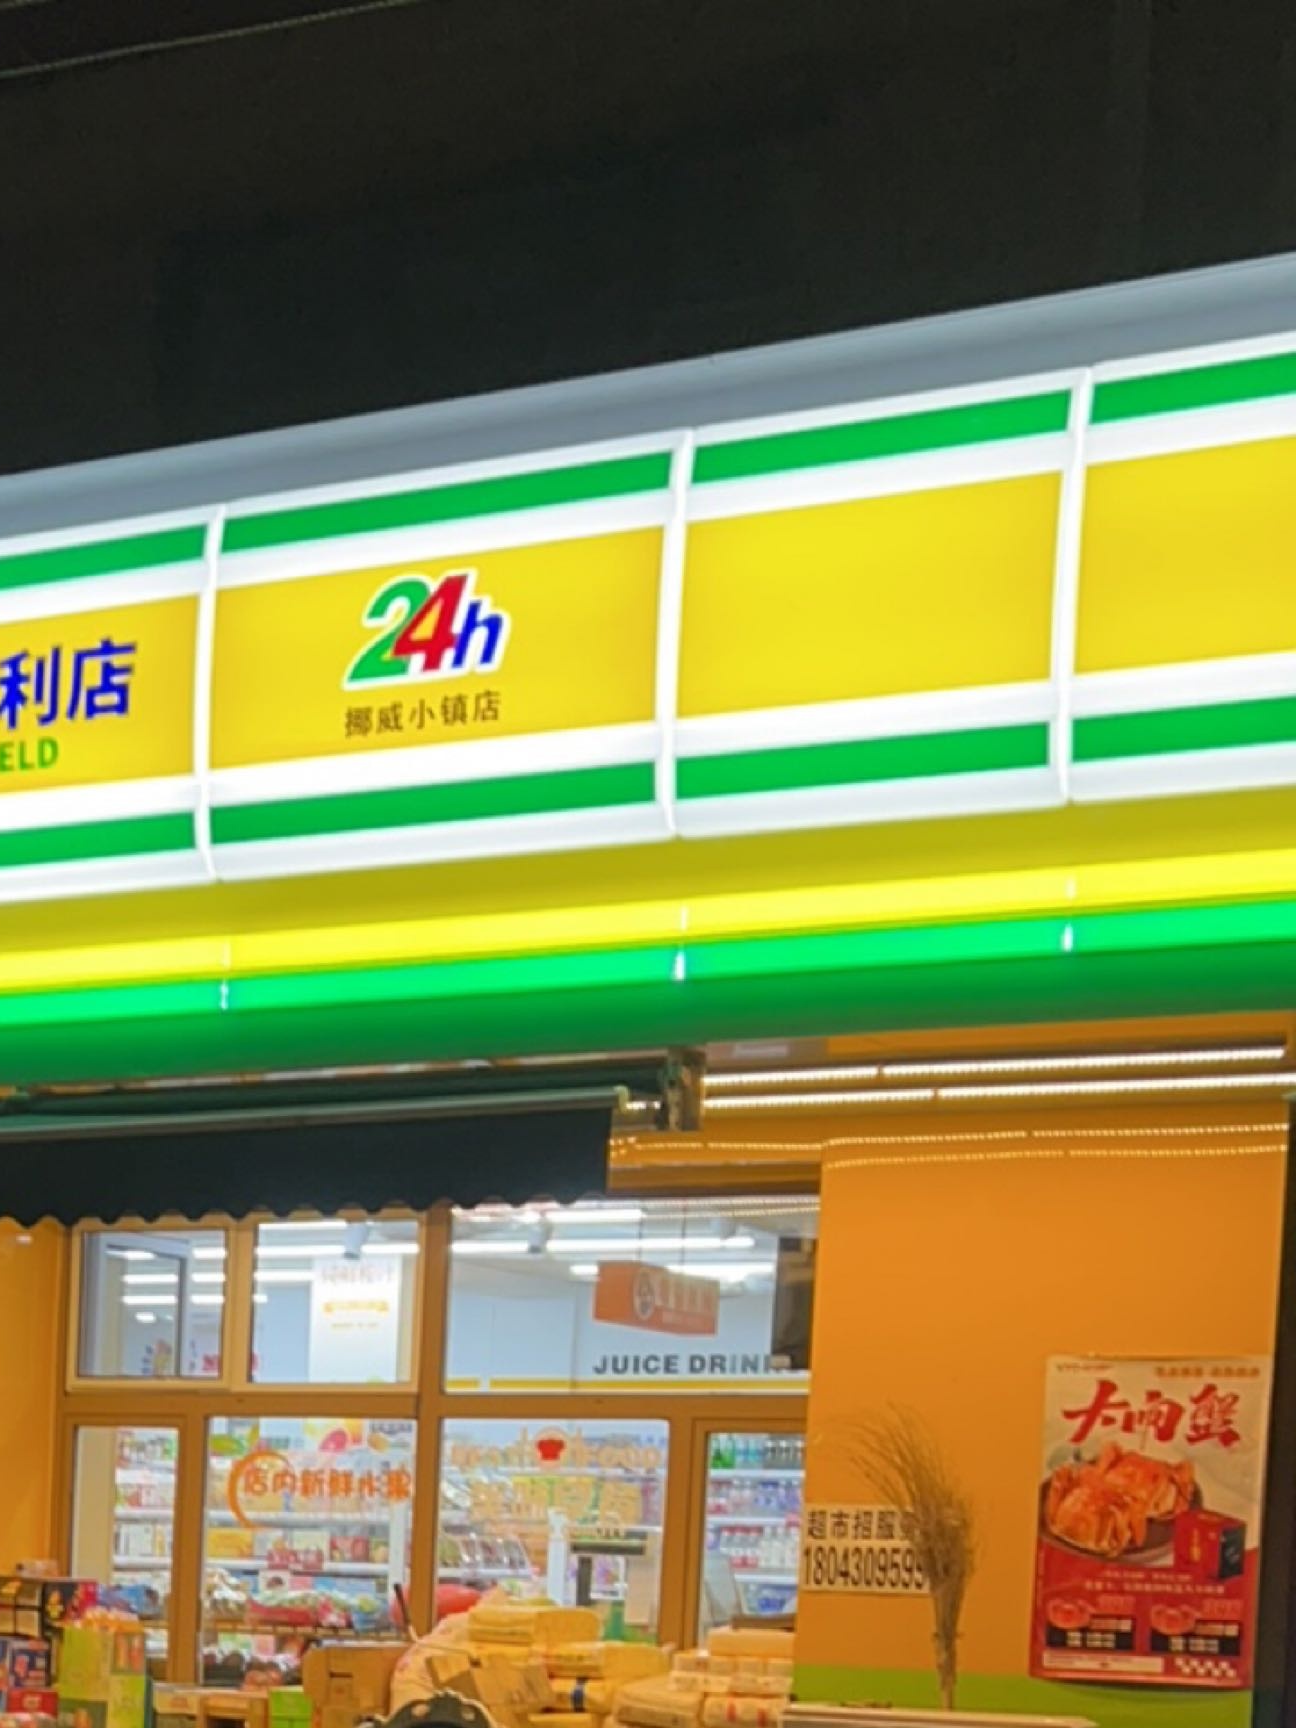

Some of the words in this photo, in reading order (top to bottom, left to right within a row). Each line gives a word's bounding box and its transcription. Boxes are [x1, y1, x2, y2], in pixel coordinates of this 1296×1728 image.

[346, 571, 507, 686] 24h
[345, 690, 501, 738] 挪威小镇店
[593, 1354, 678, 1375] JUICE
[688, 1354, 800, 1375] DRIN
